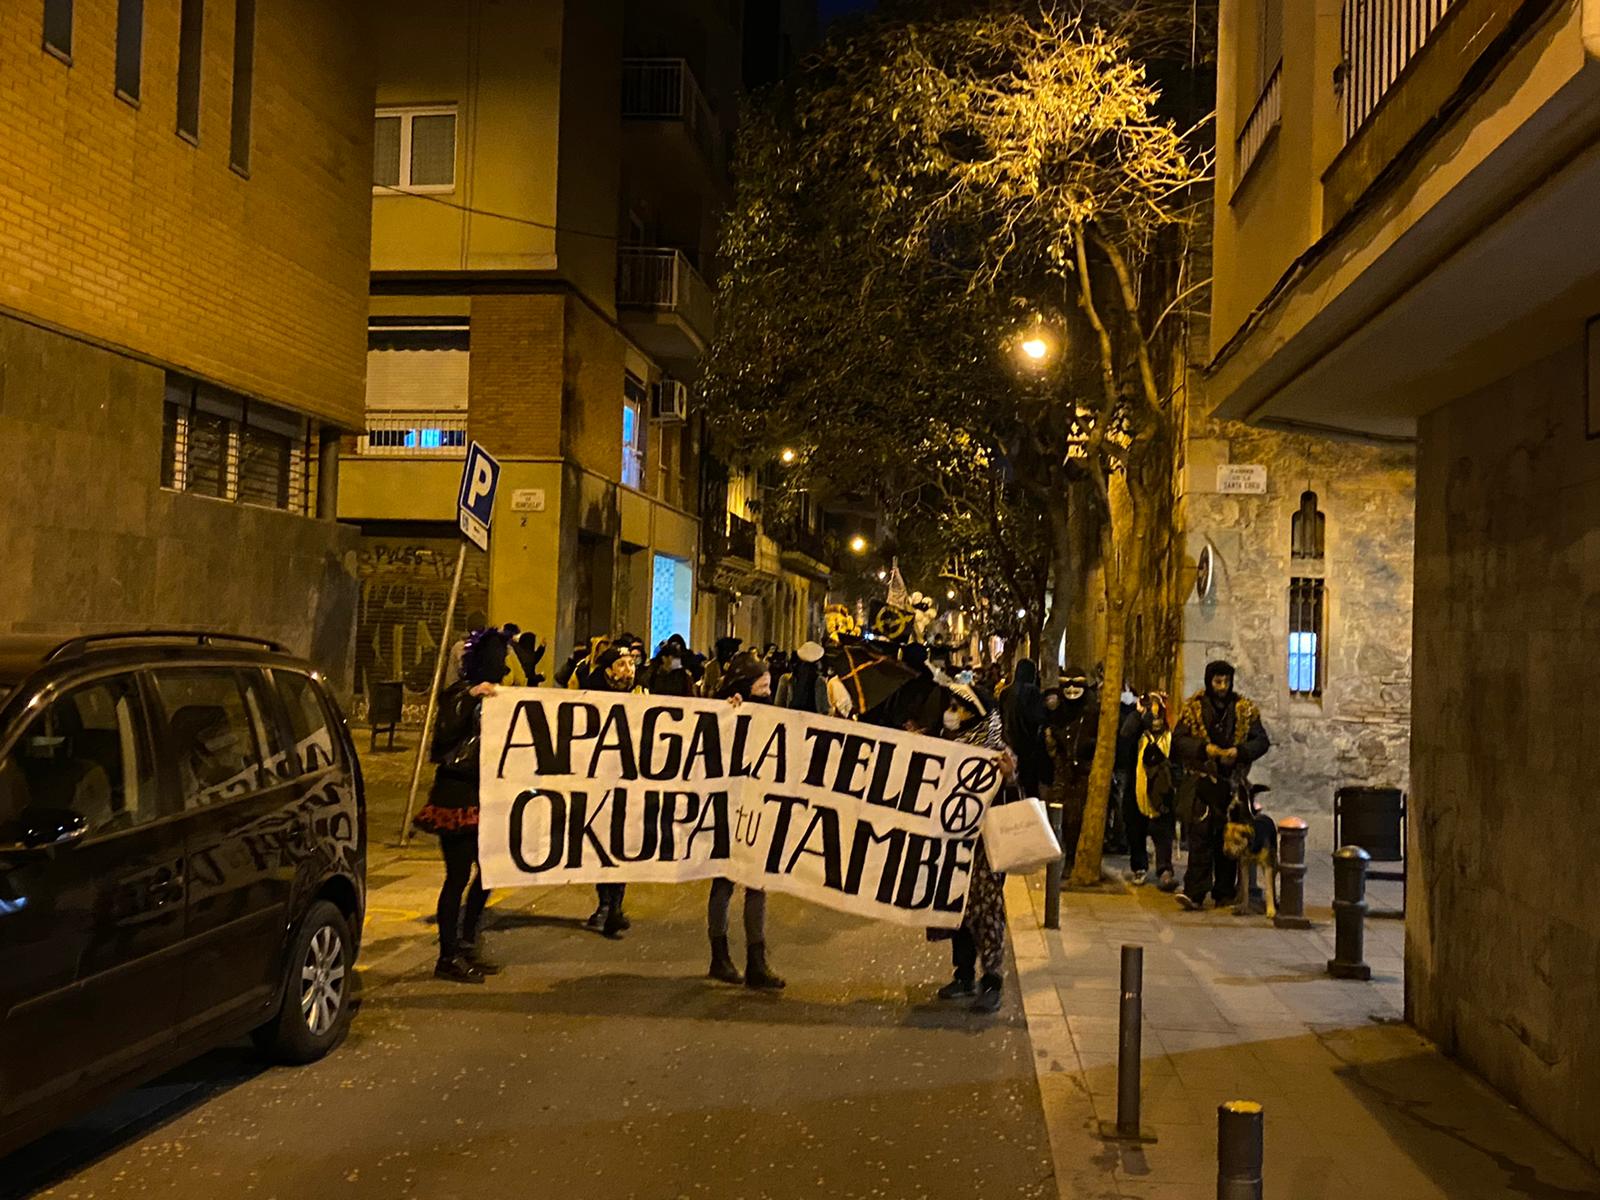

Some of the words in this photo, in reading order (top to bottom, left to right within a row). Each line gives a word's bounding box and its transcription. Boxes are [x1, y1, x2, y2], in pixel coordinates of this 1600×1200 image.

[468, 453, 492, 508] P
[497, 700, 724, 781] APAGA
[728, 714, 786, 783] LA
[801, 726, 946, 818] TELE
[509, 787, 730, 873] OKUPA
[735, 804, 762, 846] tu
